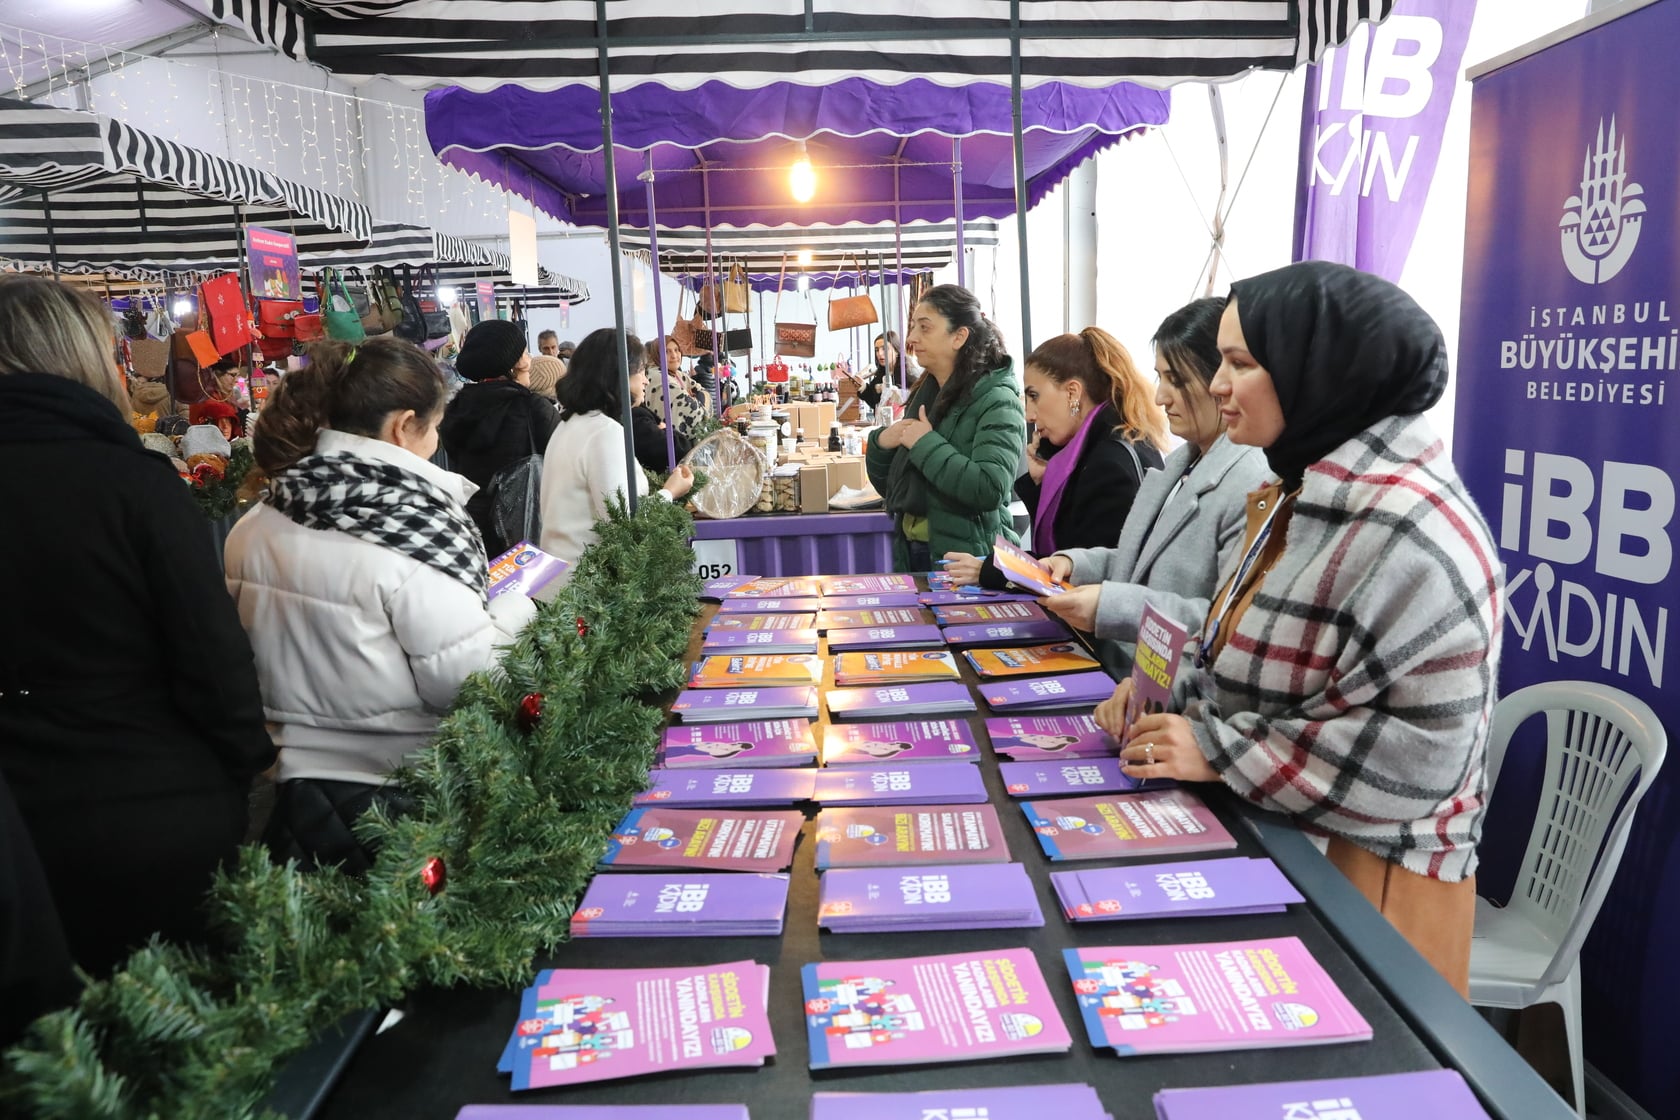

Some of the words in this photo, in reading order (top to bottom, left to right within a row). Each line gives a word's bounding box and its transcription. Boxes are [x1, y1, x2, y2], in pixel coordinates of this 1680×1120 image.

[1530, 300, 1671, 328] İSTANBUL
[1500, 328, 1680, 374] BÜYÜKŞEHİ
[1526, 379, 1666, 406] BELEDİYESİ
[698, 563, 732, 580] 052
[951, 962, 997, 1043] YANINDAYIZ!
[1214, 951, 1273, 1031] YANINDAYIZ!
[675, 977, 702, 1058] YANINDAYIZ!
